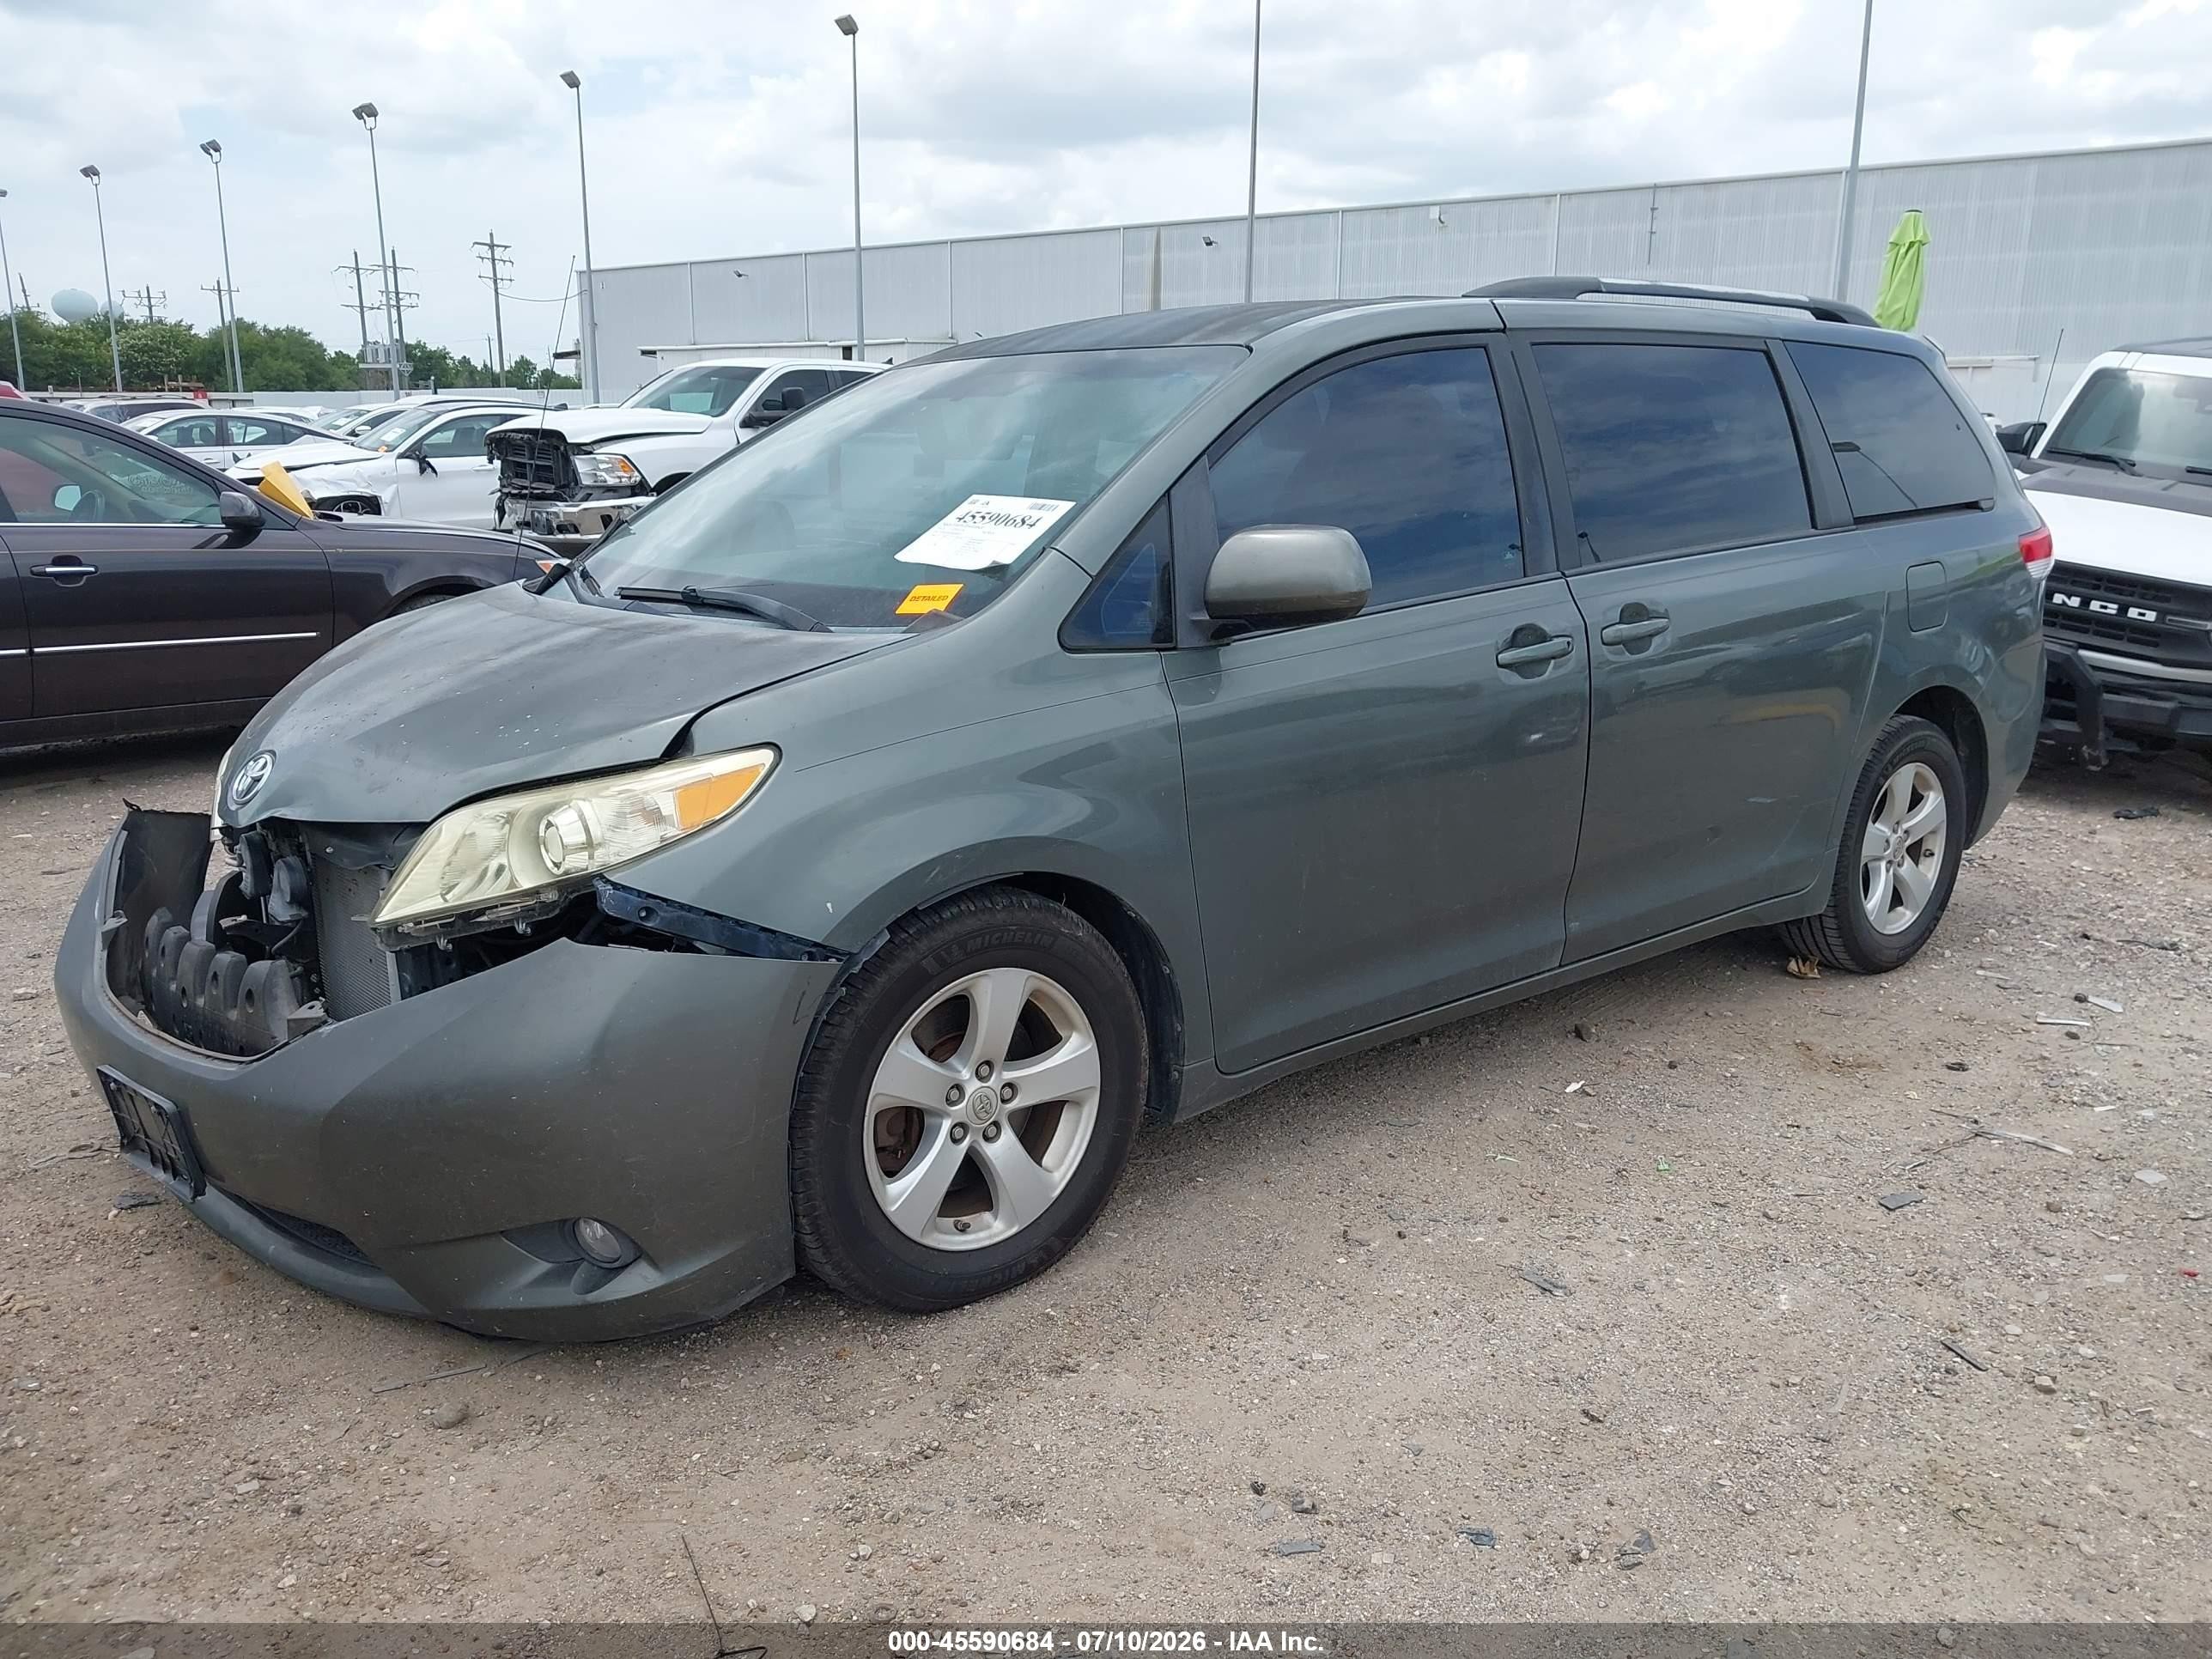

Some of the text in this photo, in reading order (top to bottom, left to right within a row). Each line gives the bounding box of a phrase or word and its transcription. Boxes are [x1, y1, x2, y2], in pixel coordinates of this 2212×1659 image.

[956, 510, 1043, 530] 45590684
[2052, 592, 2158, 623] NCO
[966, 933, 1054, 951] MICHELIN
